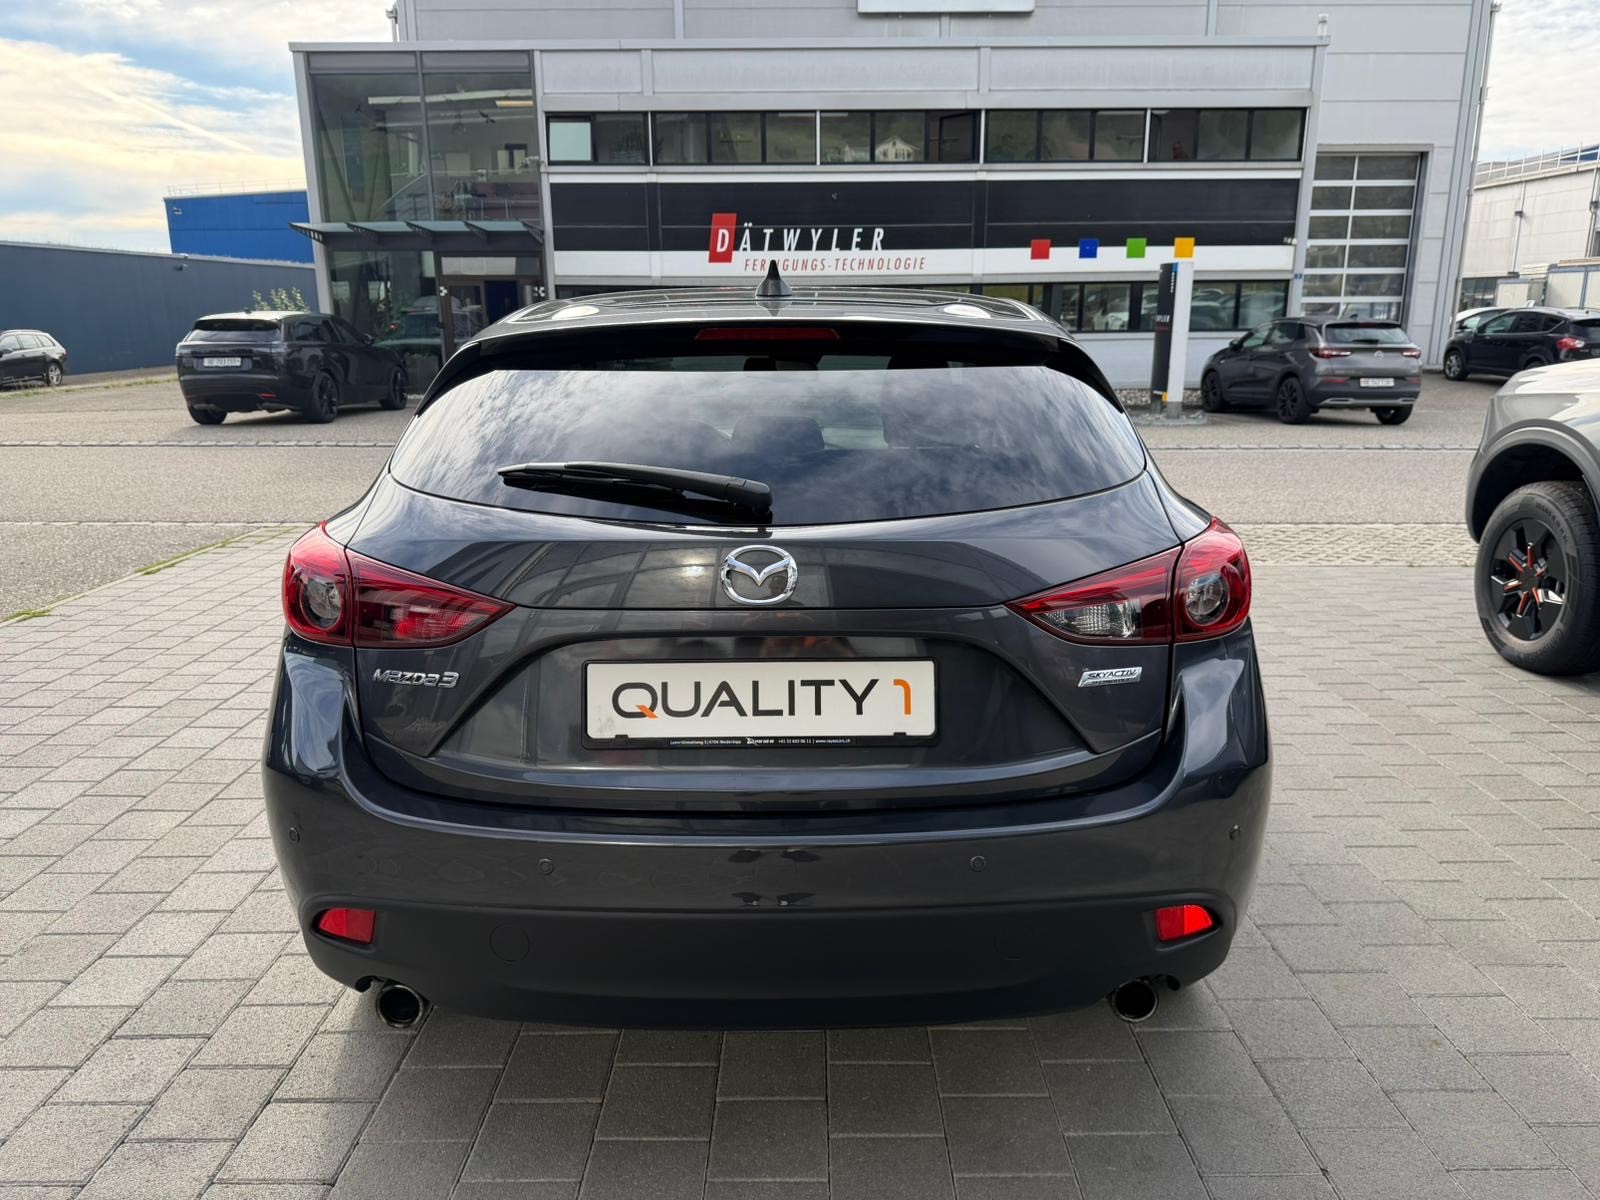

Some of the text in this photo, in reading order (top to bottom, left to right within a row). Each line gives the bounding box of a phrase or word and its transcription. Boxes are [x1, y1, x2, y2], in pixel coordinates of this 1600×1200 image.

[715, 222, 885, 253] DÄTWYLER
[744, 256, 926, 272] FERIGUNGS-TECHNOLOGIE
[1088, 669, 1137, 679] SKYACTIV
[611, 678, 912, 719] QUALITY 1
